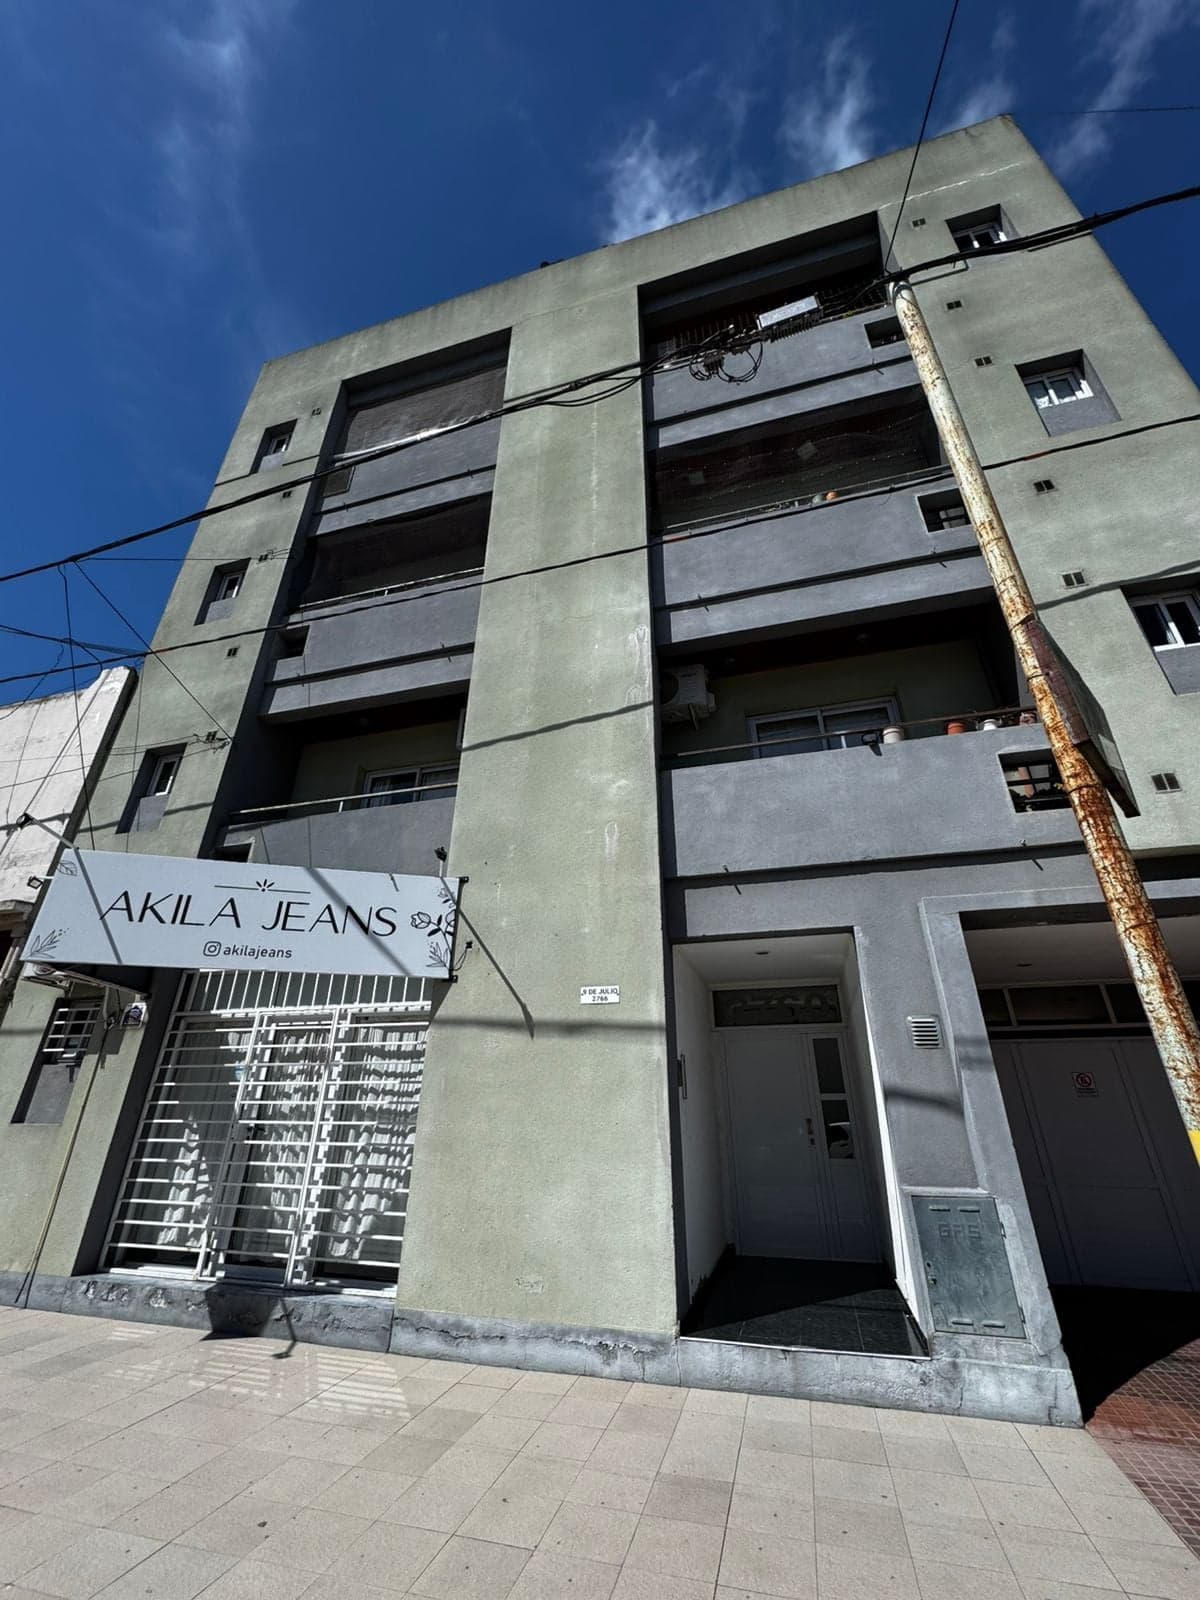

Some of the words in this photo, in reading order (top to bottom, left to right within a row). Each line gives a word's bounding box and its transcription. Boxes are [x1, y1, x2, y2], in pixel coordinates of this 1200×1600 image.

[100, 889, 242, 929] AKILA
[261, 900, 398, 937] JEANS
[223, 943, 293, 960] akilajeans
[938, 1223, 982, 1240] GAS
